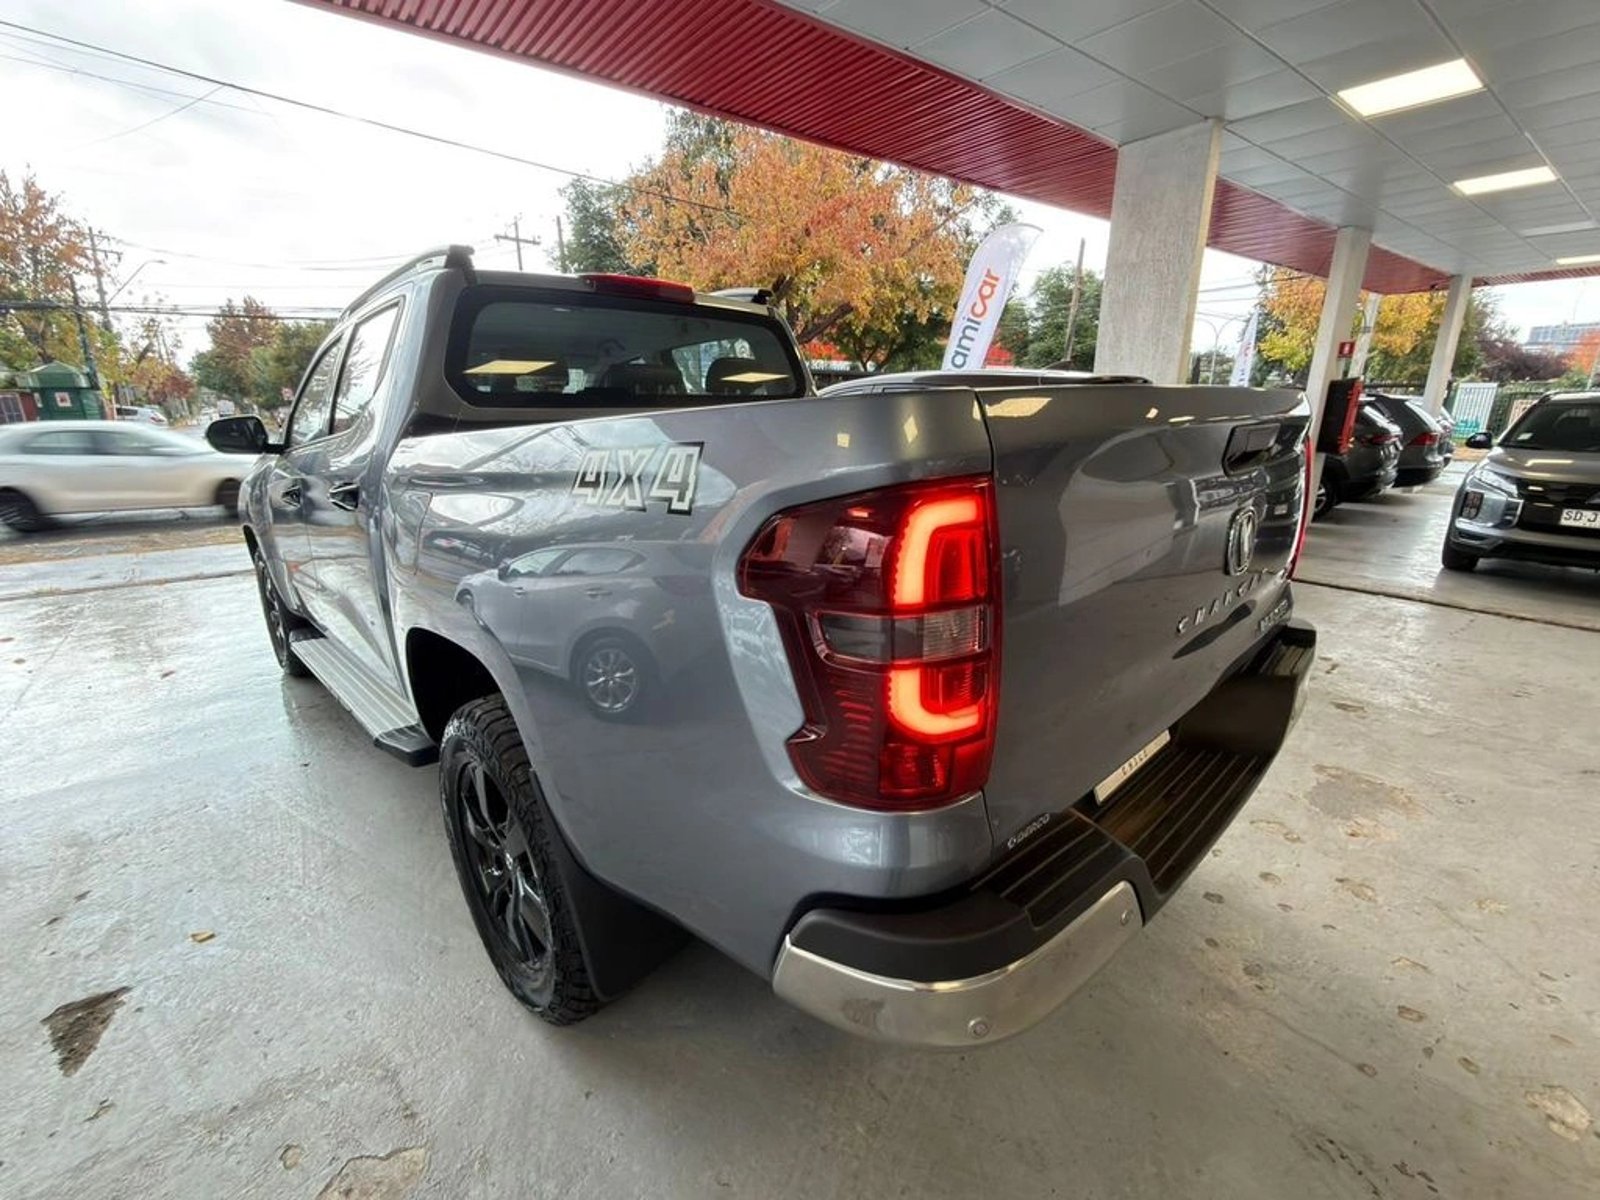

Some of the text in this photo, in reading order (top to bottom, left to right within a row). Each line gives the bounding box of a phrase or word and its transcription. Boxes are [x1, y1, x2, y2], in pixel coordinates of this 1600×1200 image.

[950, 268, 1001, 369] amicar
[572, 441, 704, 516] 4X4
[1176, 571, 1266, 634] CHANGA
